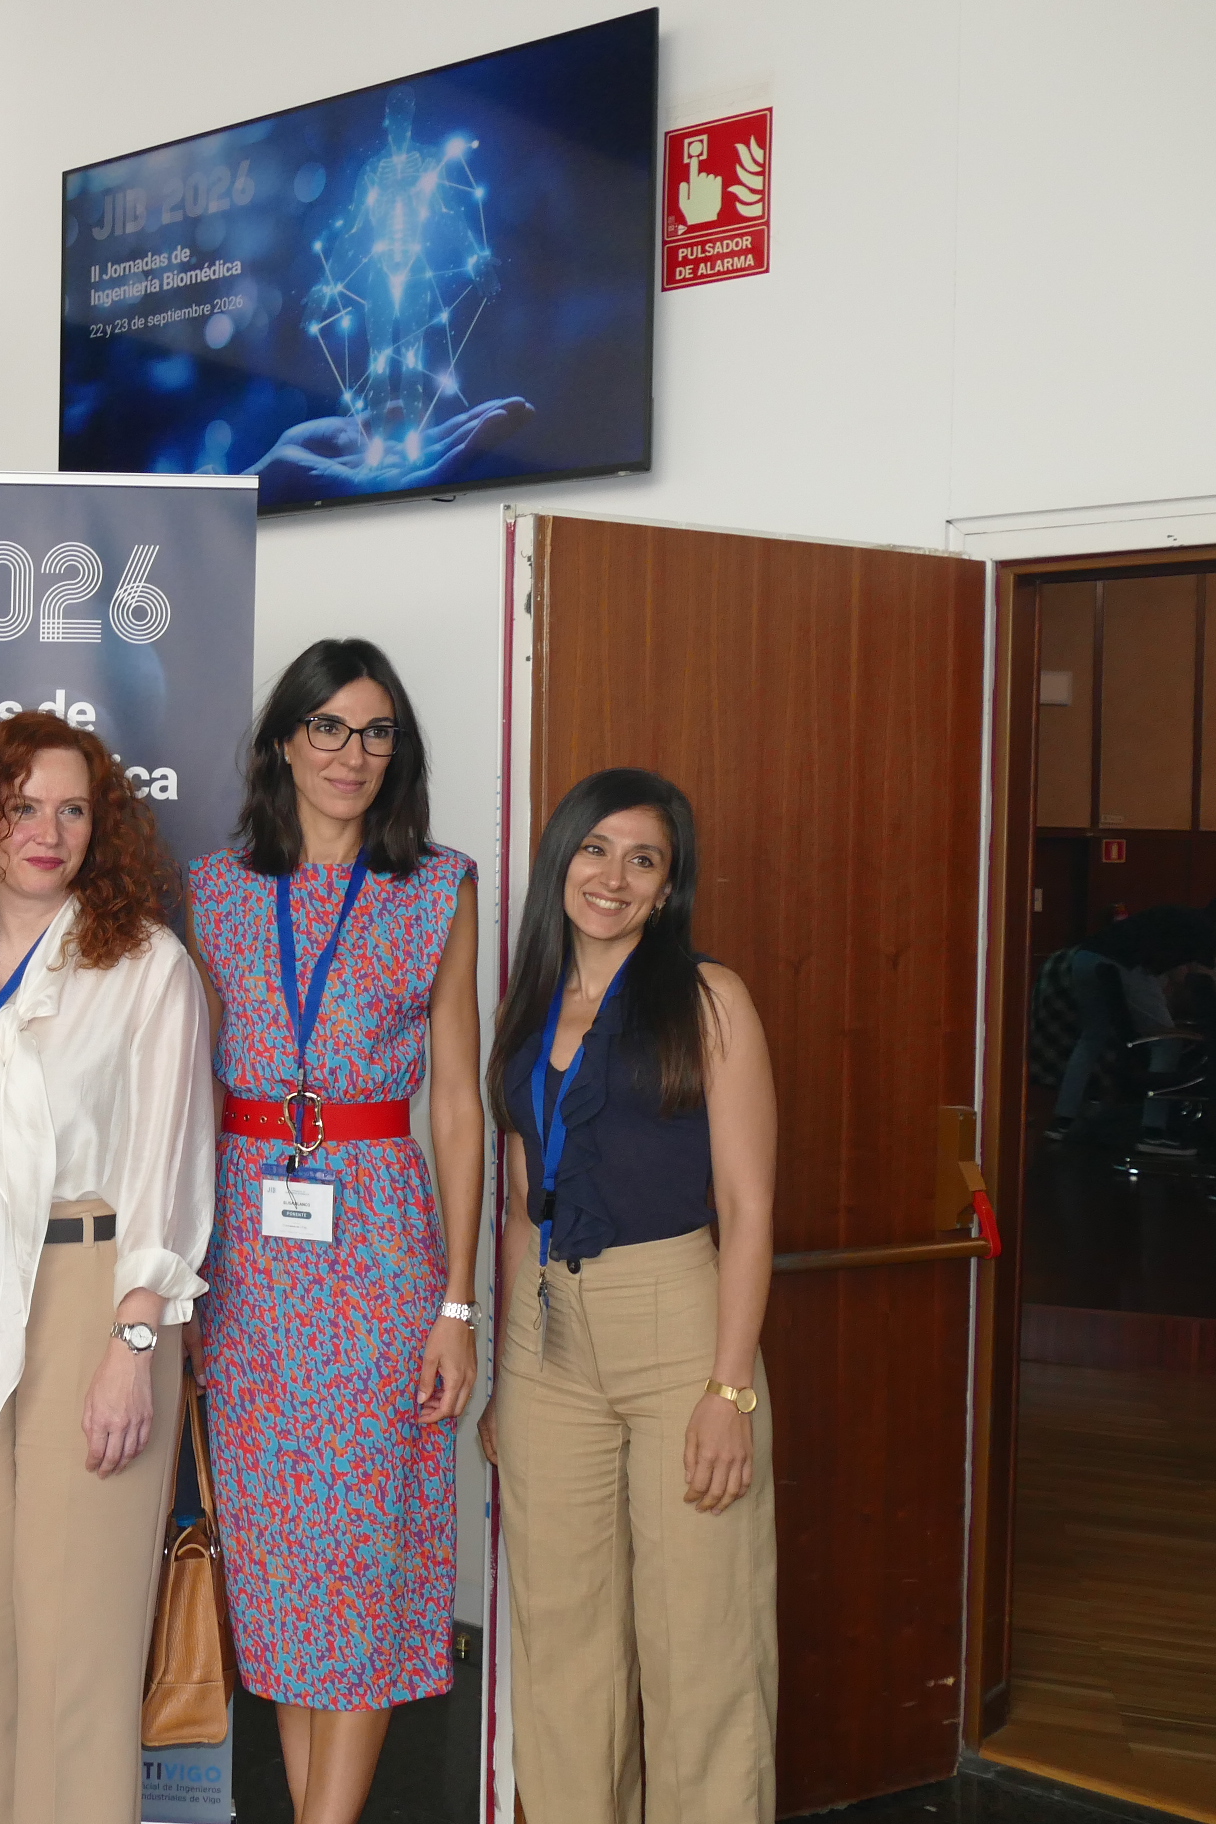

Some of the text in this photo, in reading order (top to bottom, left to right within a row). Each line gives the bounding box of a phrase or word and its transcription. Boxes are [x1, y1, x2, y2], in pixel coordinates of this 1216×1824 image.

[92, 159, 256, 240] JIB 2026
[91, 244, 191, 283] II Jornadas de
[678, 236, 752, 262] PULSADOR
[675, 254, 755, 280] DE ALARMA
[90, 260, 242, 307] Ingeniería Biomédica
[89, 294, 244, 338] 22 y 23 de septiembre 2026
[162, 1782, 173, 1791] de
[176, 1783, 222, 1794] Ingenieros
[189, 1795, 200, 1803] de
[202, 1797, 222, 1805] Vigo
